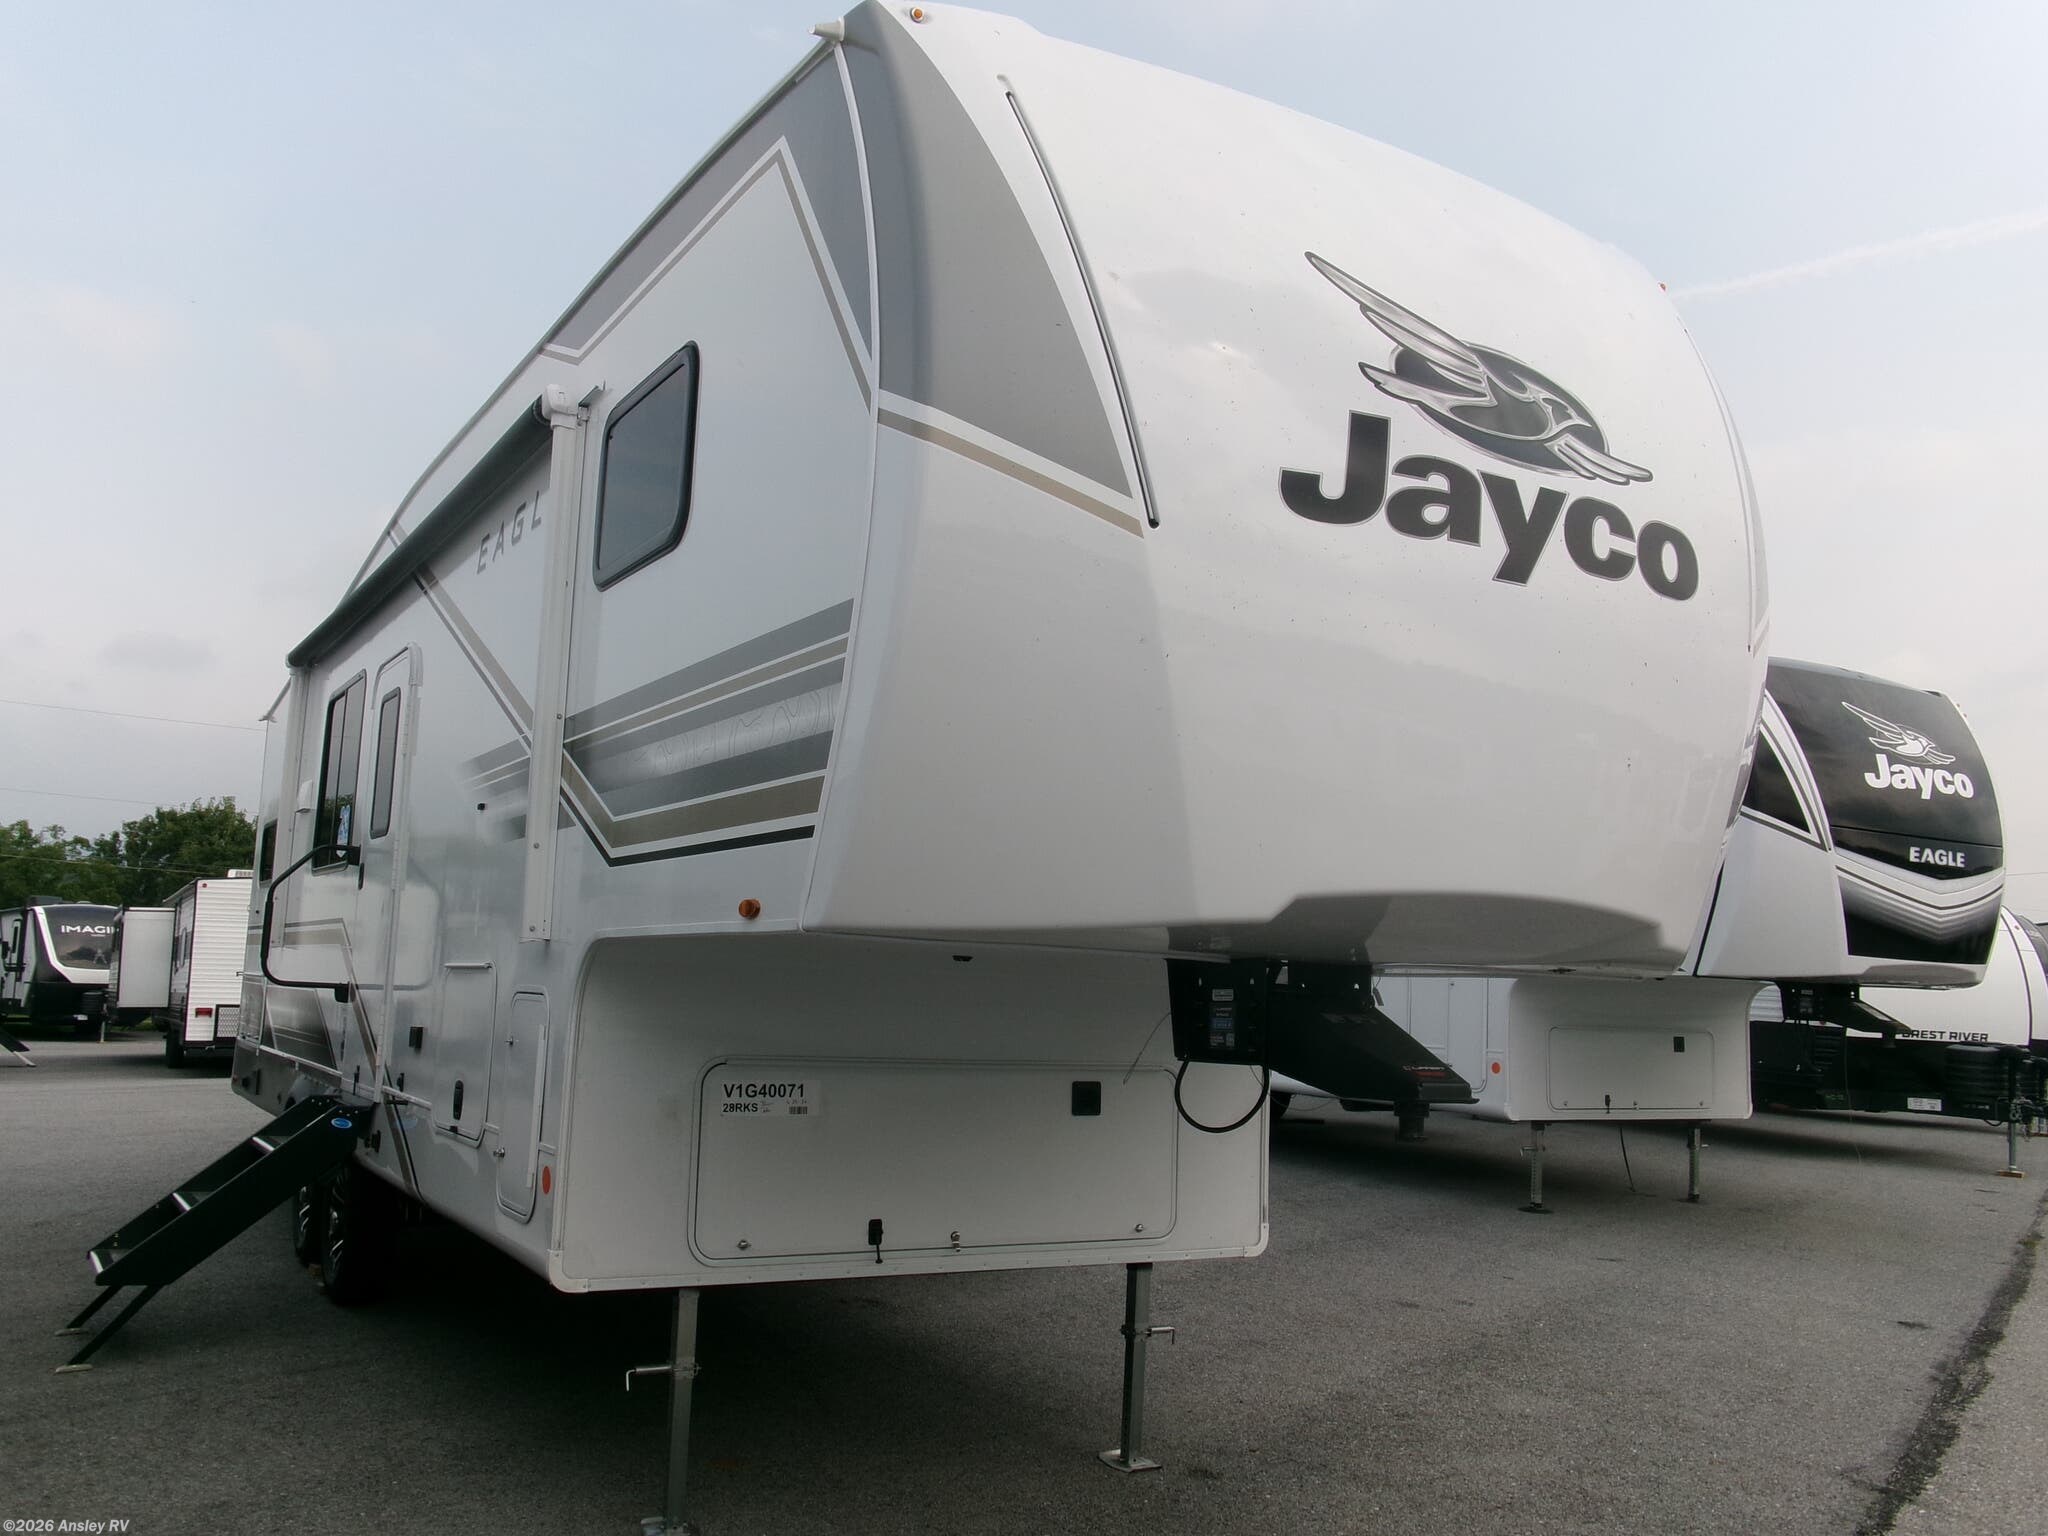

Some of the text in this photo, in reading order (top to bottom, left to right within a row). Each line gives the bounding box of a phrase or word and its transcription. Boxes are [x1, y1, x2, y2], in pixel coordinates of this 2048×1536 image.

[1278, 410, 1700, 601] Jayco
[477, 490, 542, 574] EAGL
[1864, 754, 1974, 799] Jayco
[1909, 846, 1965, 868] EAGLE
[61, 925, 115, 934] IMAGI
[1949, 1031, 1989, 1042] RIVER
[723, 1083, 804, 1098] V1G40071
[722, 1103, 758, 1113] 28RKS
